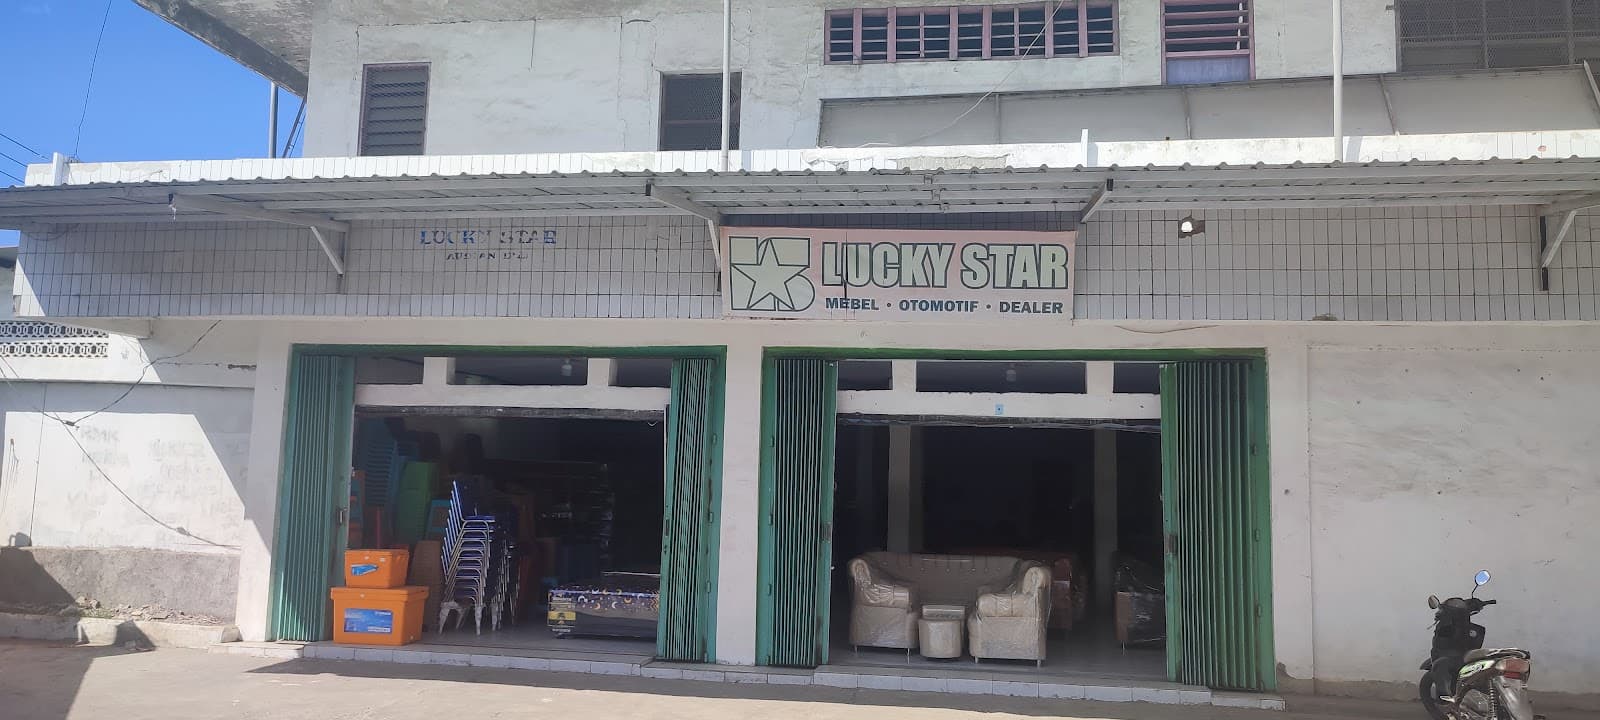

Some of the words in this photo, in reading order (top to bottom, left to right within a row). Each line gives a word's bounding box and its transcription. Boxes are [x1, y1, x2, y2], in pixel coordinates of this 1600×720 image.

[821, 241, 956, 288] LUCKY
[960, 243, 1069, 289] STAR
[825, 297, 880, 311] MEBEL
[898, 299, 980, 313] OTOMOTIF
[999, 300, 1064, 314] DEALER
